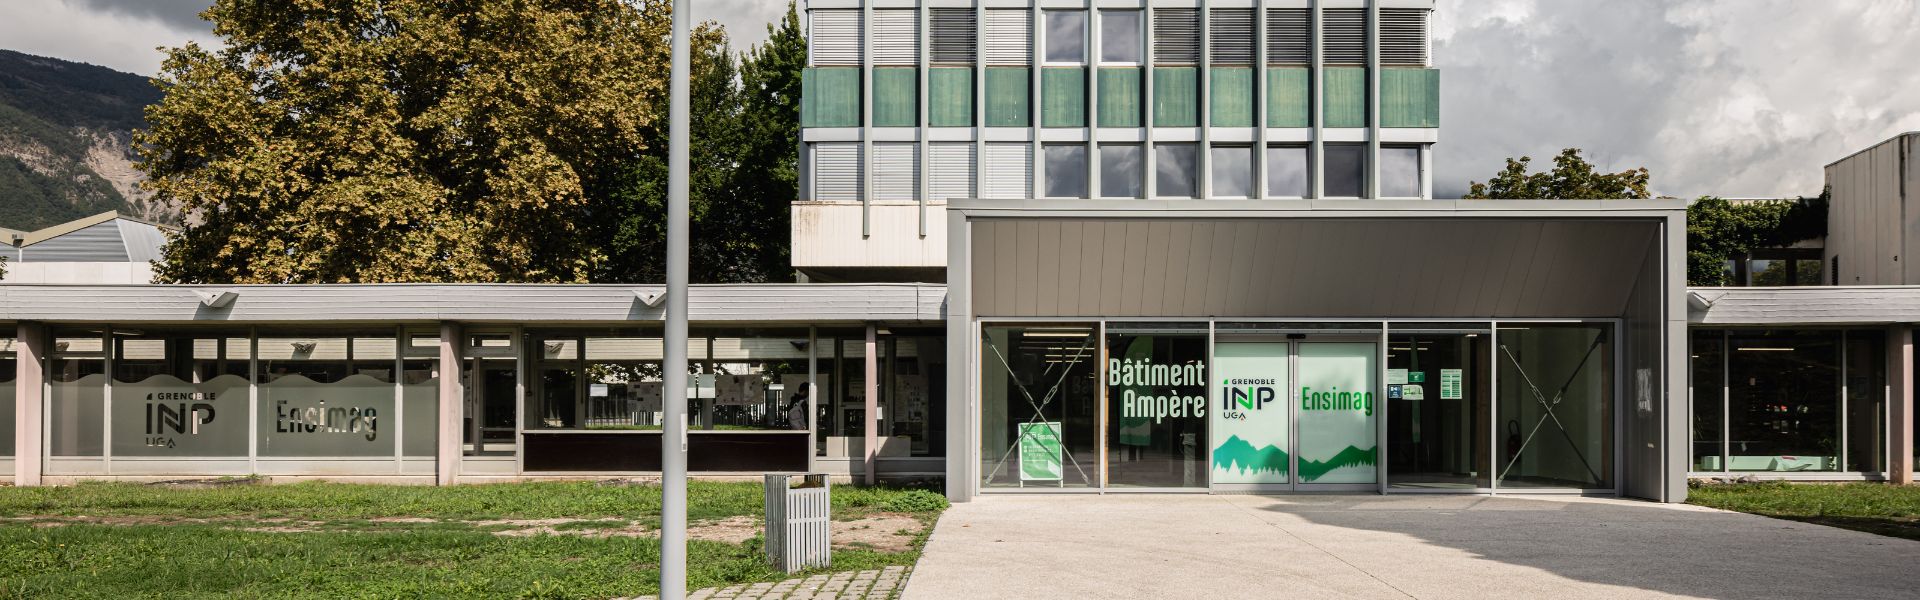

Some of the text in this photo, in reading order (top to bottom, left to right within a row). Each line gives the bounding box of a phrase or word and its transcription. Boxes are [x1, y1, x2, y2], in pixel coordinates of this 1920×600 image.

[1109, 358, 1205, 387] Bâtiment
[157, 392, 216, 401] GRENOBLE
[1123, 389, 1205, 425] Ampère
[1223, 379, 1275, 410] INP
[1302, 386, 1373, 417] Ensimag
[145, 393, 216, 435] INP
[276, 400, 377, 442] Ensimag
[1223, 412, 1246, 421] UGA
[145, 437, 177, 448] UGA
